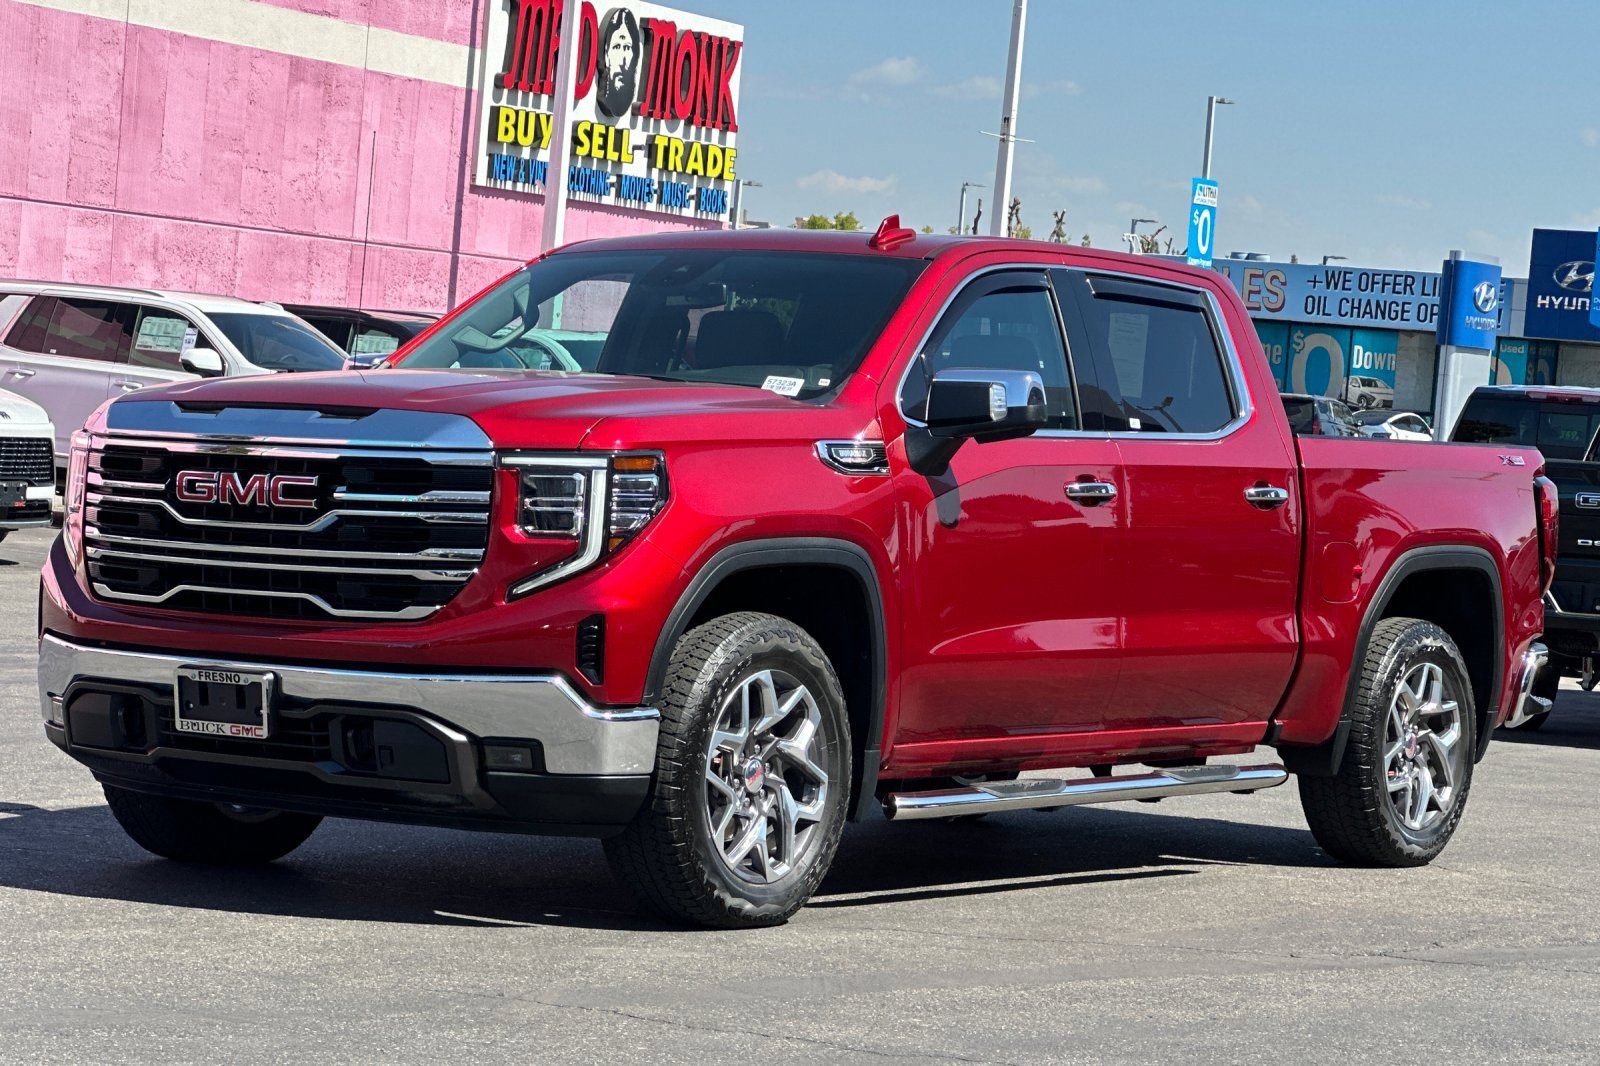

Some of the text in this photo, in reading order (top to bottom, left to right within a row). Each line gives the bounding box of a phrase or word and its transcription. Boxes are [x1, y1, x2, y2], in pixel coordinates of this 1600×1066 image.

[640, 18, 743, 133] MONK
[497, 106, 553, 150] BUY
[654, 134, 737, 182] TRADE
[493, 153, 516, 182] NEW
[518, 159, 525, 183] &
[700, 186, 728, 214] BOOKS
[1358, 272, 1415, 295] OFFER
[1421, 276, 1442, 297] LI
[1304, 295, 1332, 316] OIL
[1338, 298, 1412, 322] CHANGE
[1353, 345, 1396, 371] Down
[1500, 344, 1525, 354] Used
[176, 470, 318, 509] GMC
[198, 671, 241, 683] FRESNO
[180, 721, 264, 737] BUICK GMC
